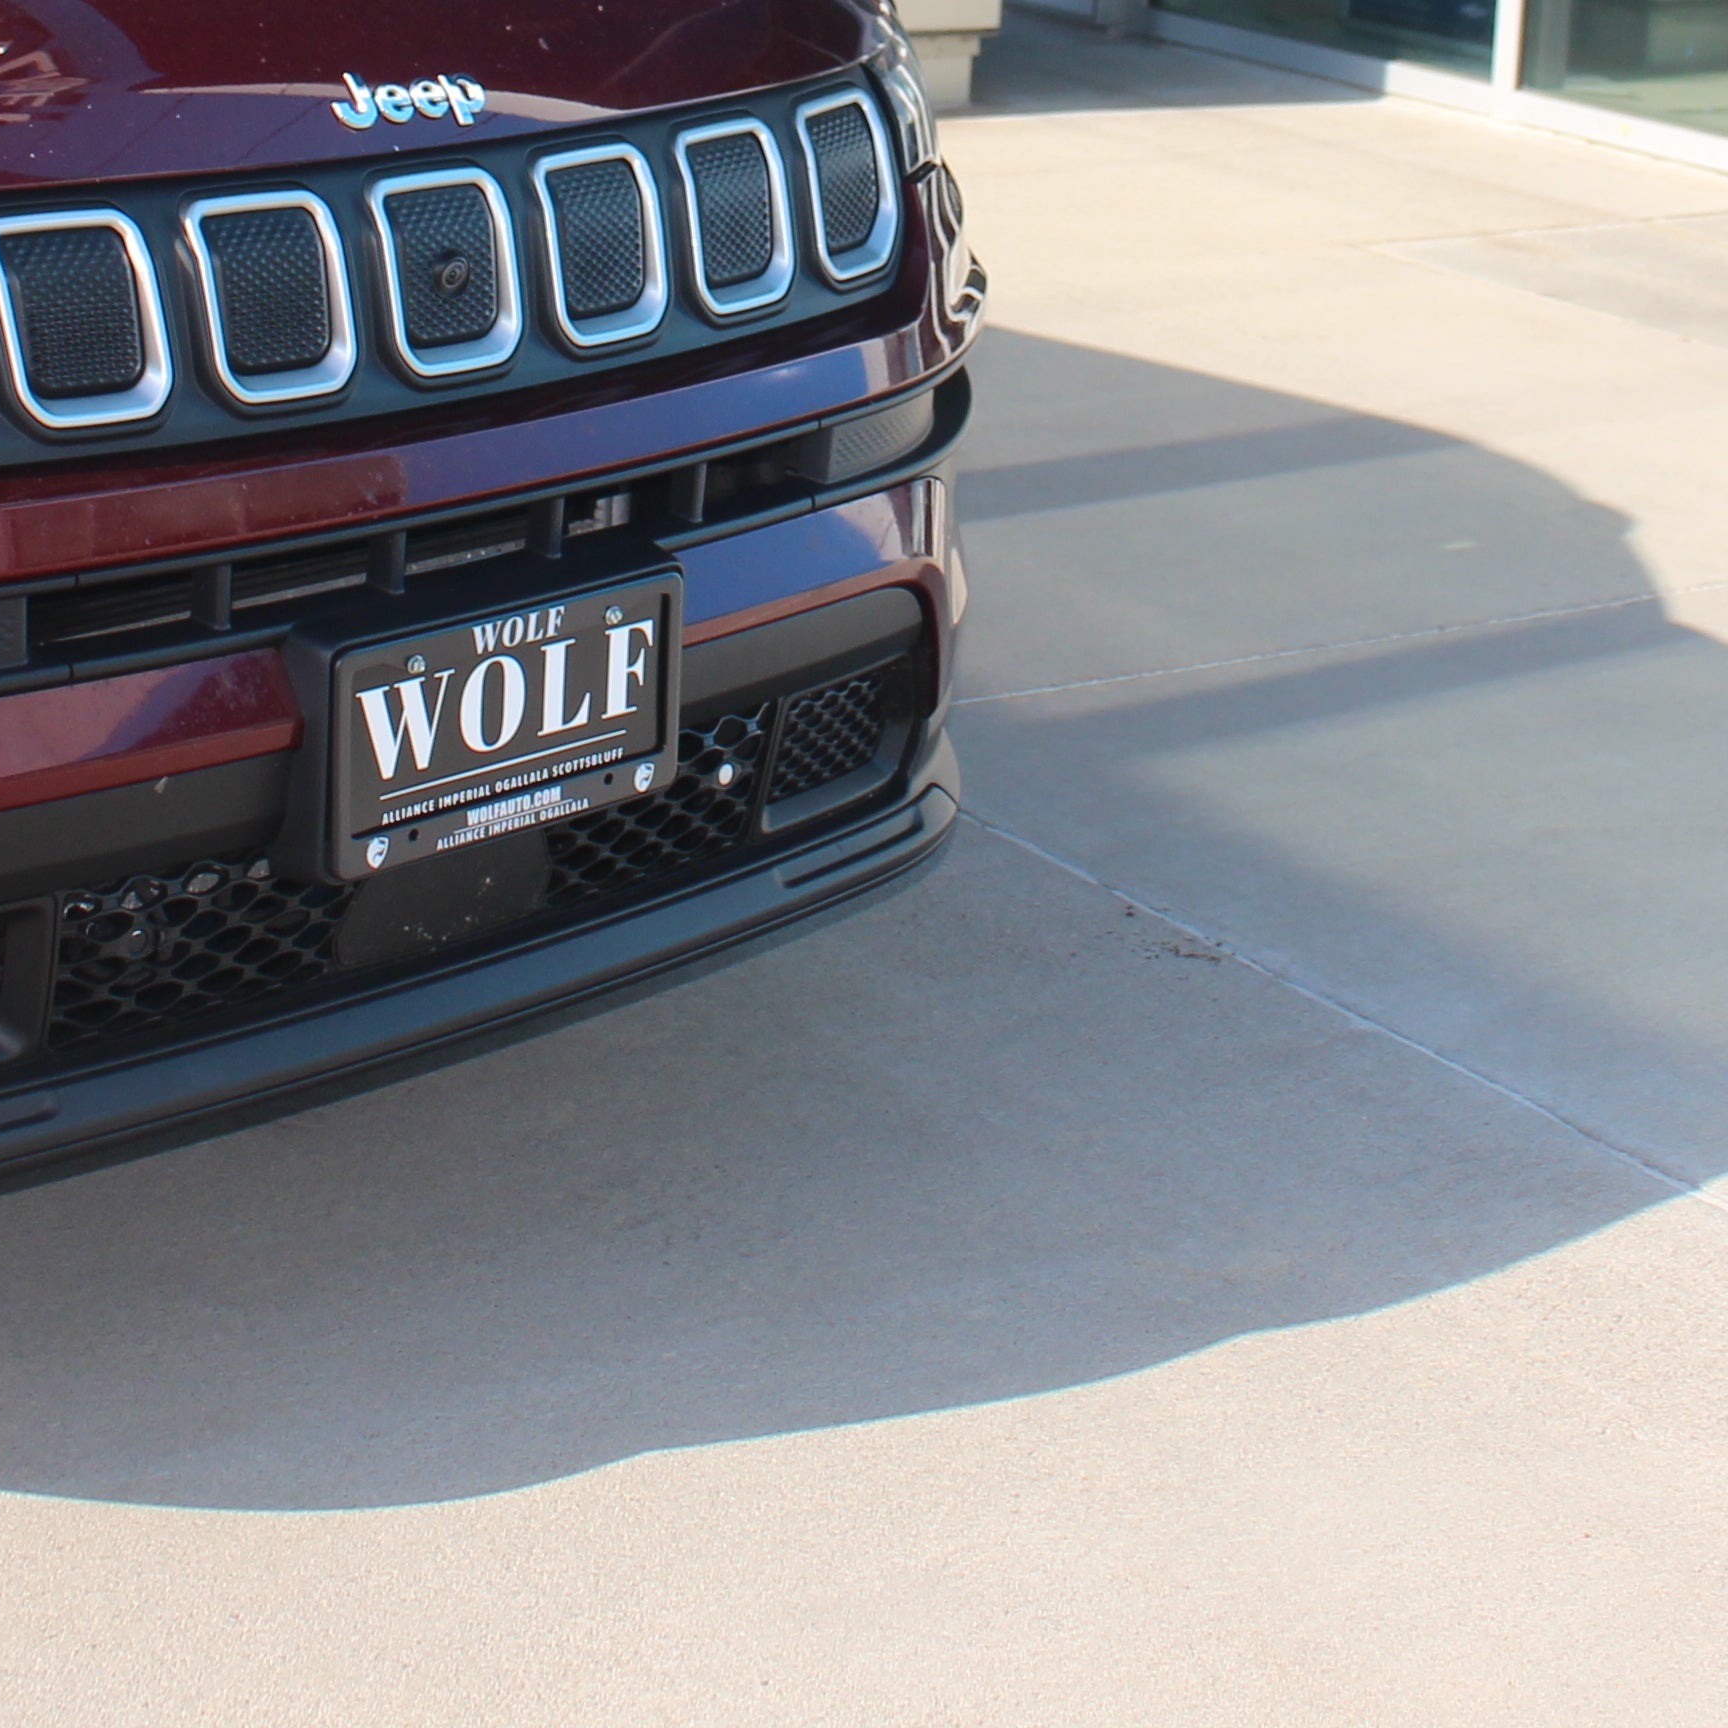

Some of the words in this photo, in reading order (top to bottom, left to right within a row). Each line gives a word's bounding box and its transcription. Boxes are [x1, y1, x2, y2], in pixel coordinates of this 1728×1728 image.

[330, 71, 487, 130] Jeep
[471, 605, 566, 656] WOLF
[355, 618, 655, 781] WOLF
[381, 799, 436, 827] ALLIANCE
[438, 786, 491, 810] IMPERIAL
[494, 769, 550, 794] OGALLALA
[552, 747, 625, 777] SCOTTSBLUFF
[466, 785, 562, 827] WOLFAUTO.COM
[435, 826, 486, 852] ALLIANCE
[488, 813, 537, 836] IMPERIAL
[539, 797, 591, 822] OGALLALA
